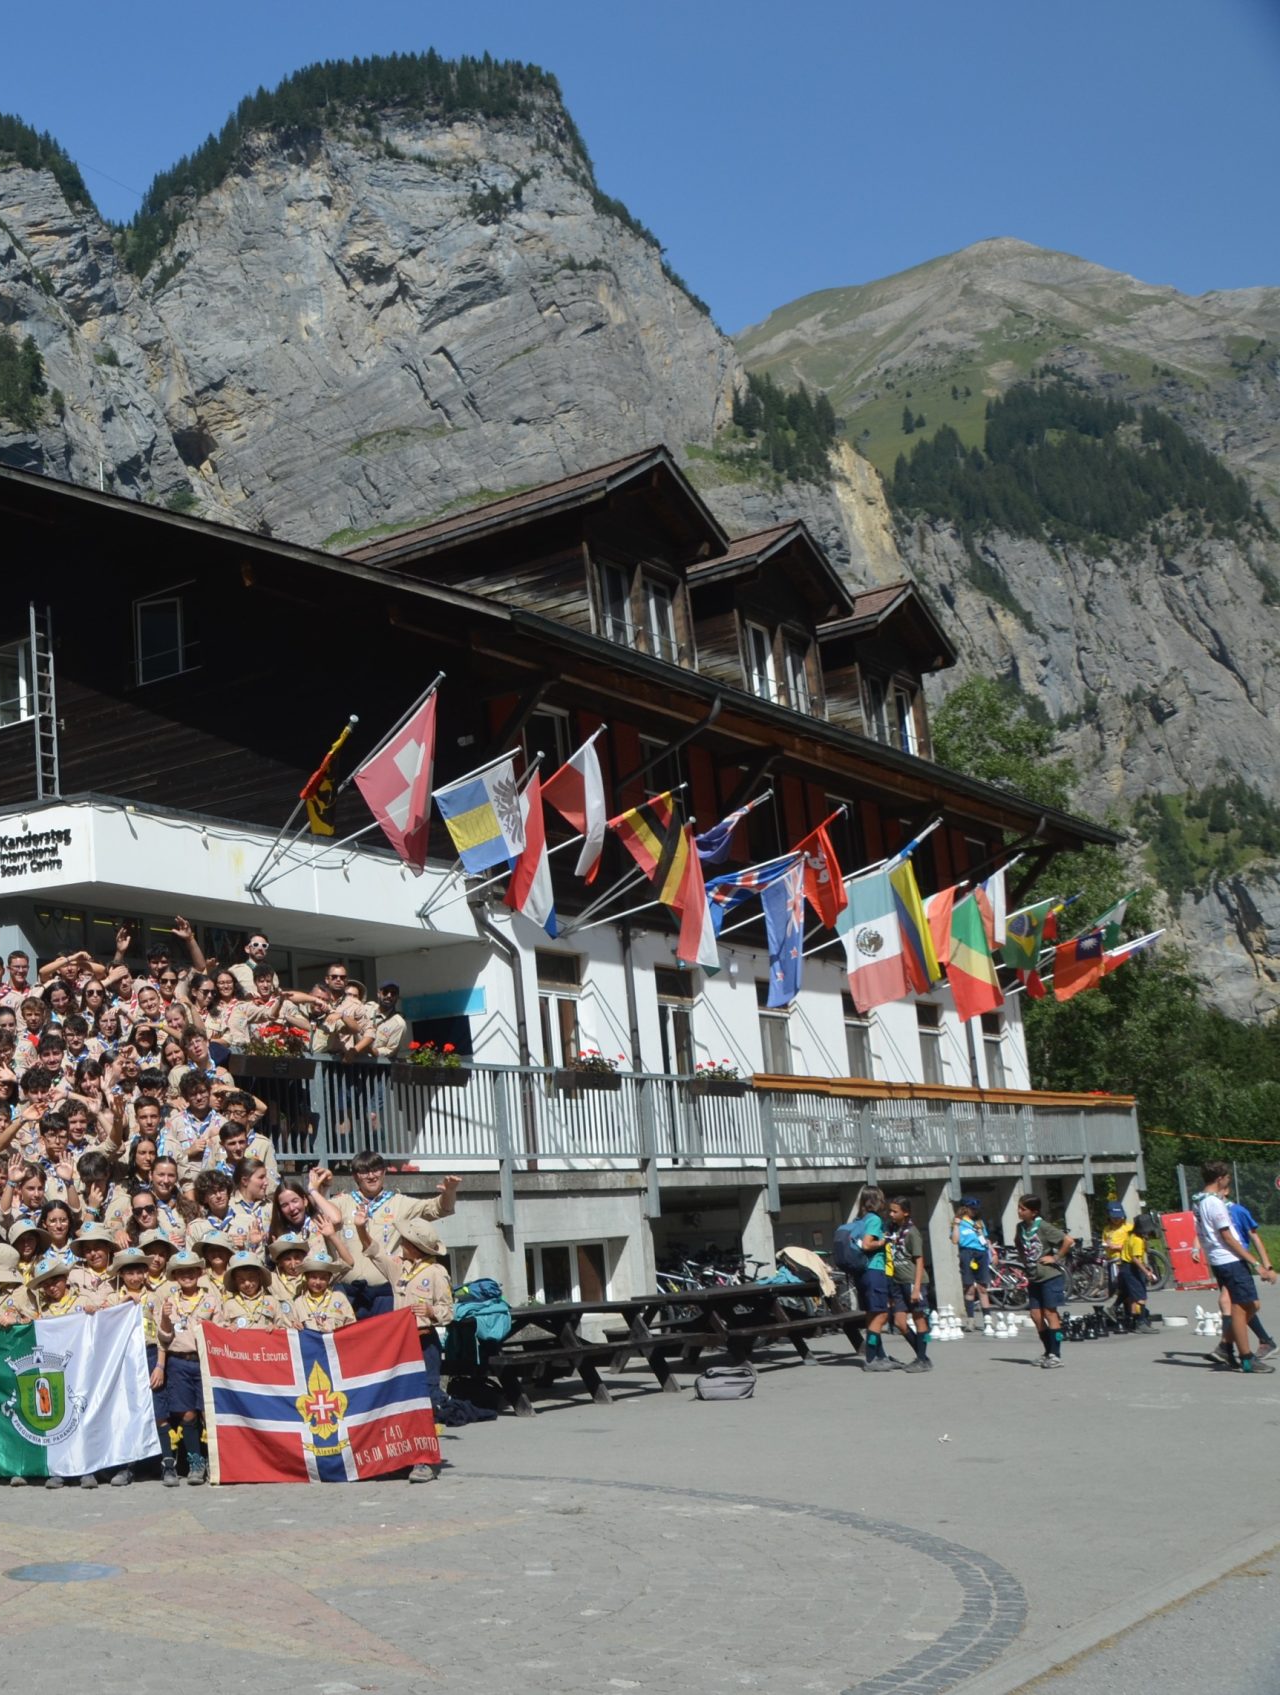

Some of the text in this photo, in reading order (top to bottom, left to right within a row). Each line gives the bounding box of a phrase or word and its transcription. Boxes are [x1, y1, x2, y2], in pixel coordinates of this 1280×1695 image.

[0, 829, 72, 851] Kandersteg
[0, 843, 58, 864] International
[0, 859, 62, 878] Scout Centre
[14, 1419, 41, 1443] FREGUESIA
[53, 1418, 77, 1442] PARANHOS
[413, 1436, 438, 1451] PORTO
